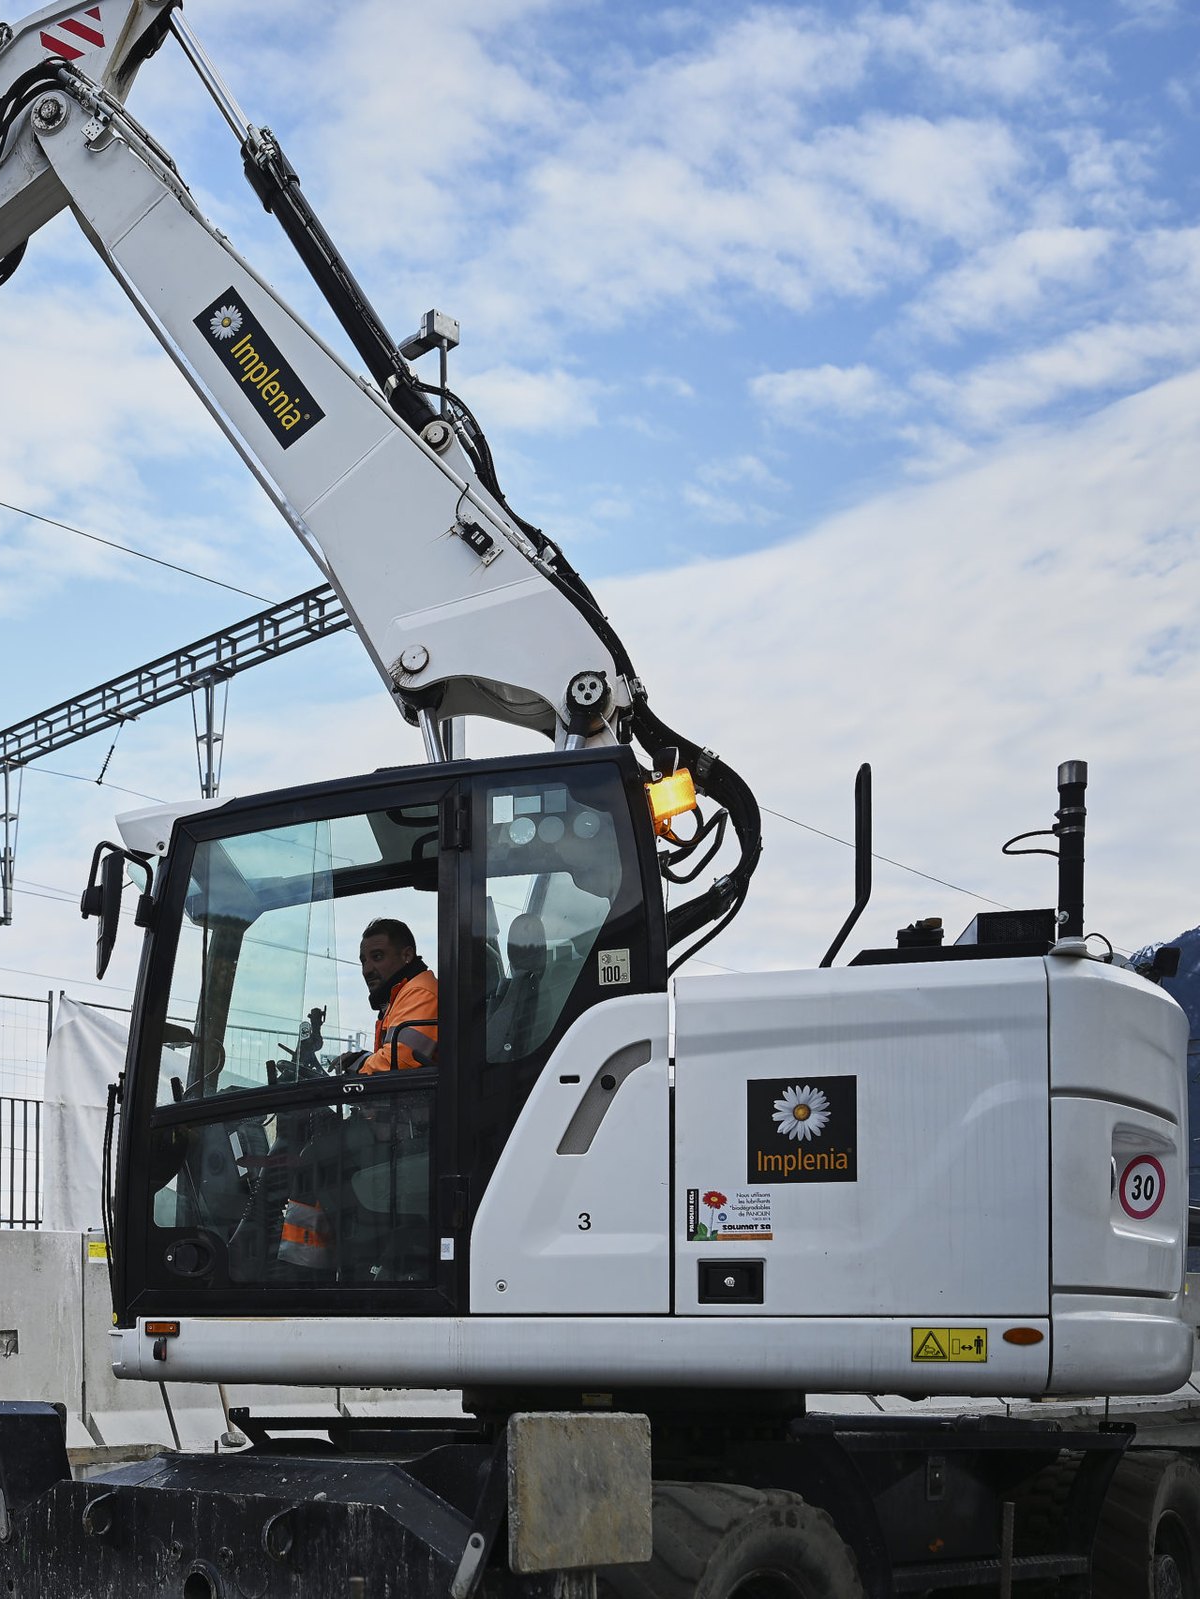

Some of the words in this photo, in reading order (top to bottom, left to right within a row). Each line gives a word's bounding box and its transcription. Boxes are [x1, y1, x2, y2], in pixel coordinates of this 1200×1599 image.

[230, 333, 301, 431] Implenia
[601, 965, 620, 983] 100
[757, 1147, 848, 1177] Implenia
[1131, 1174, 1155, 1201] 30
[578, 1212, 591, 1231] 3
